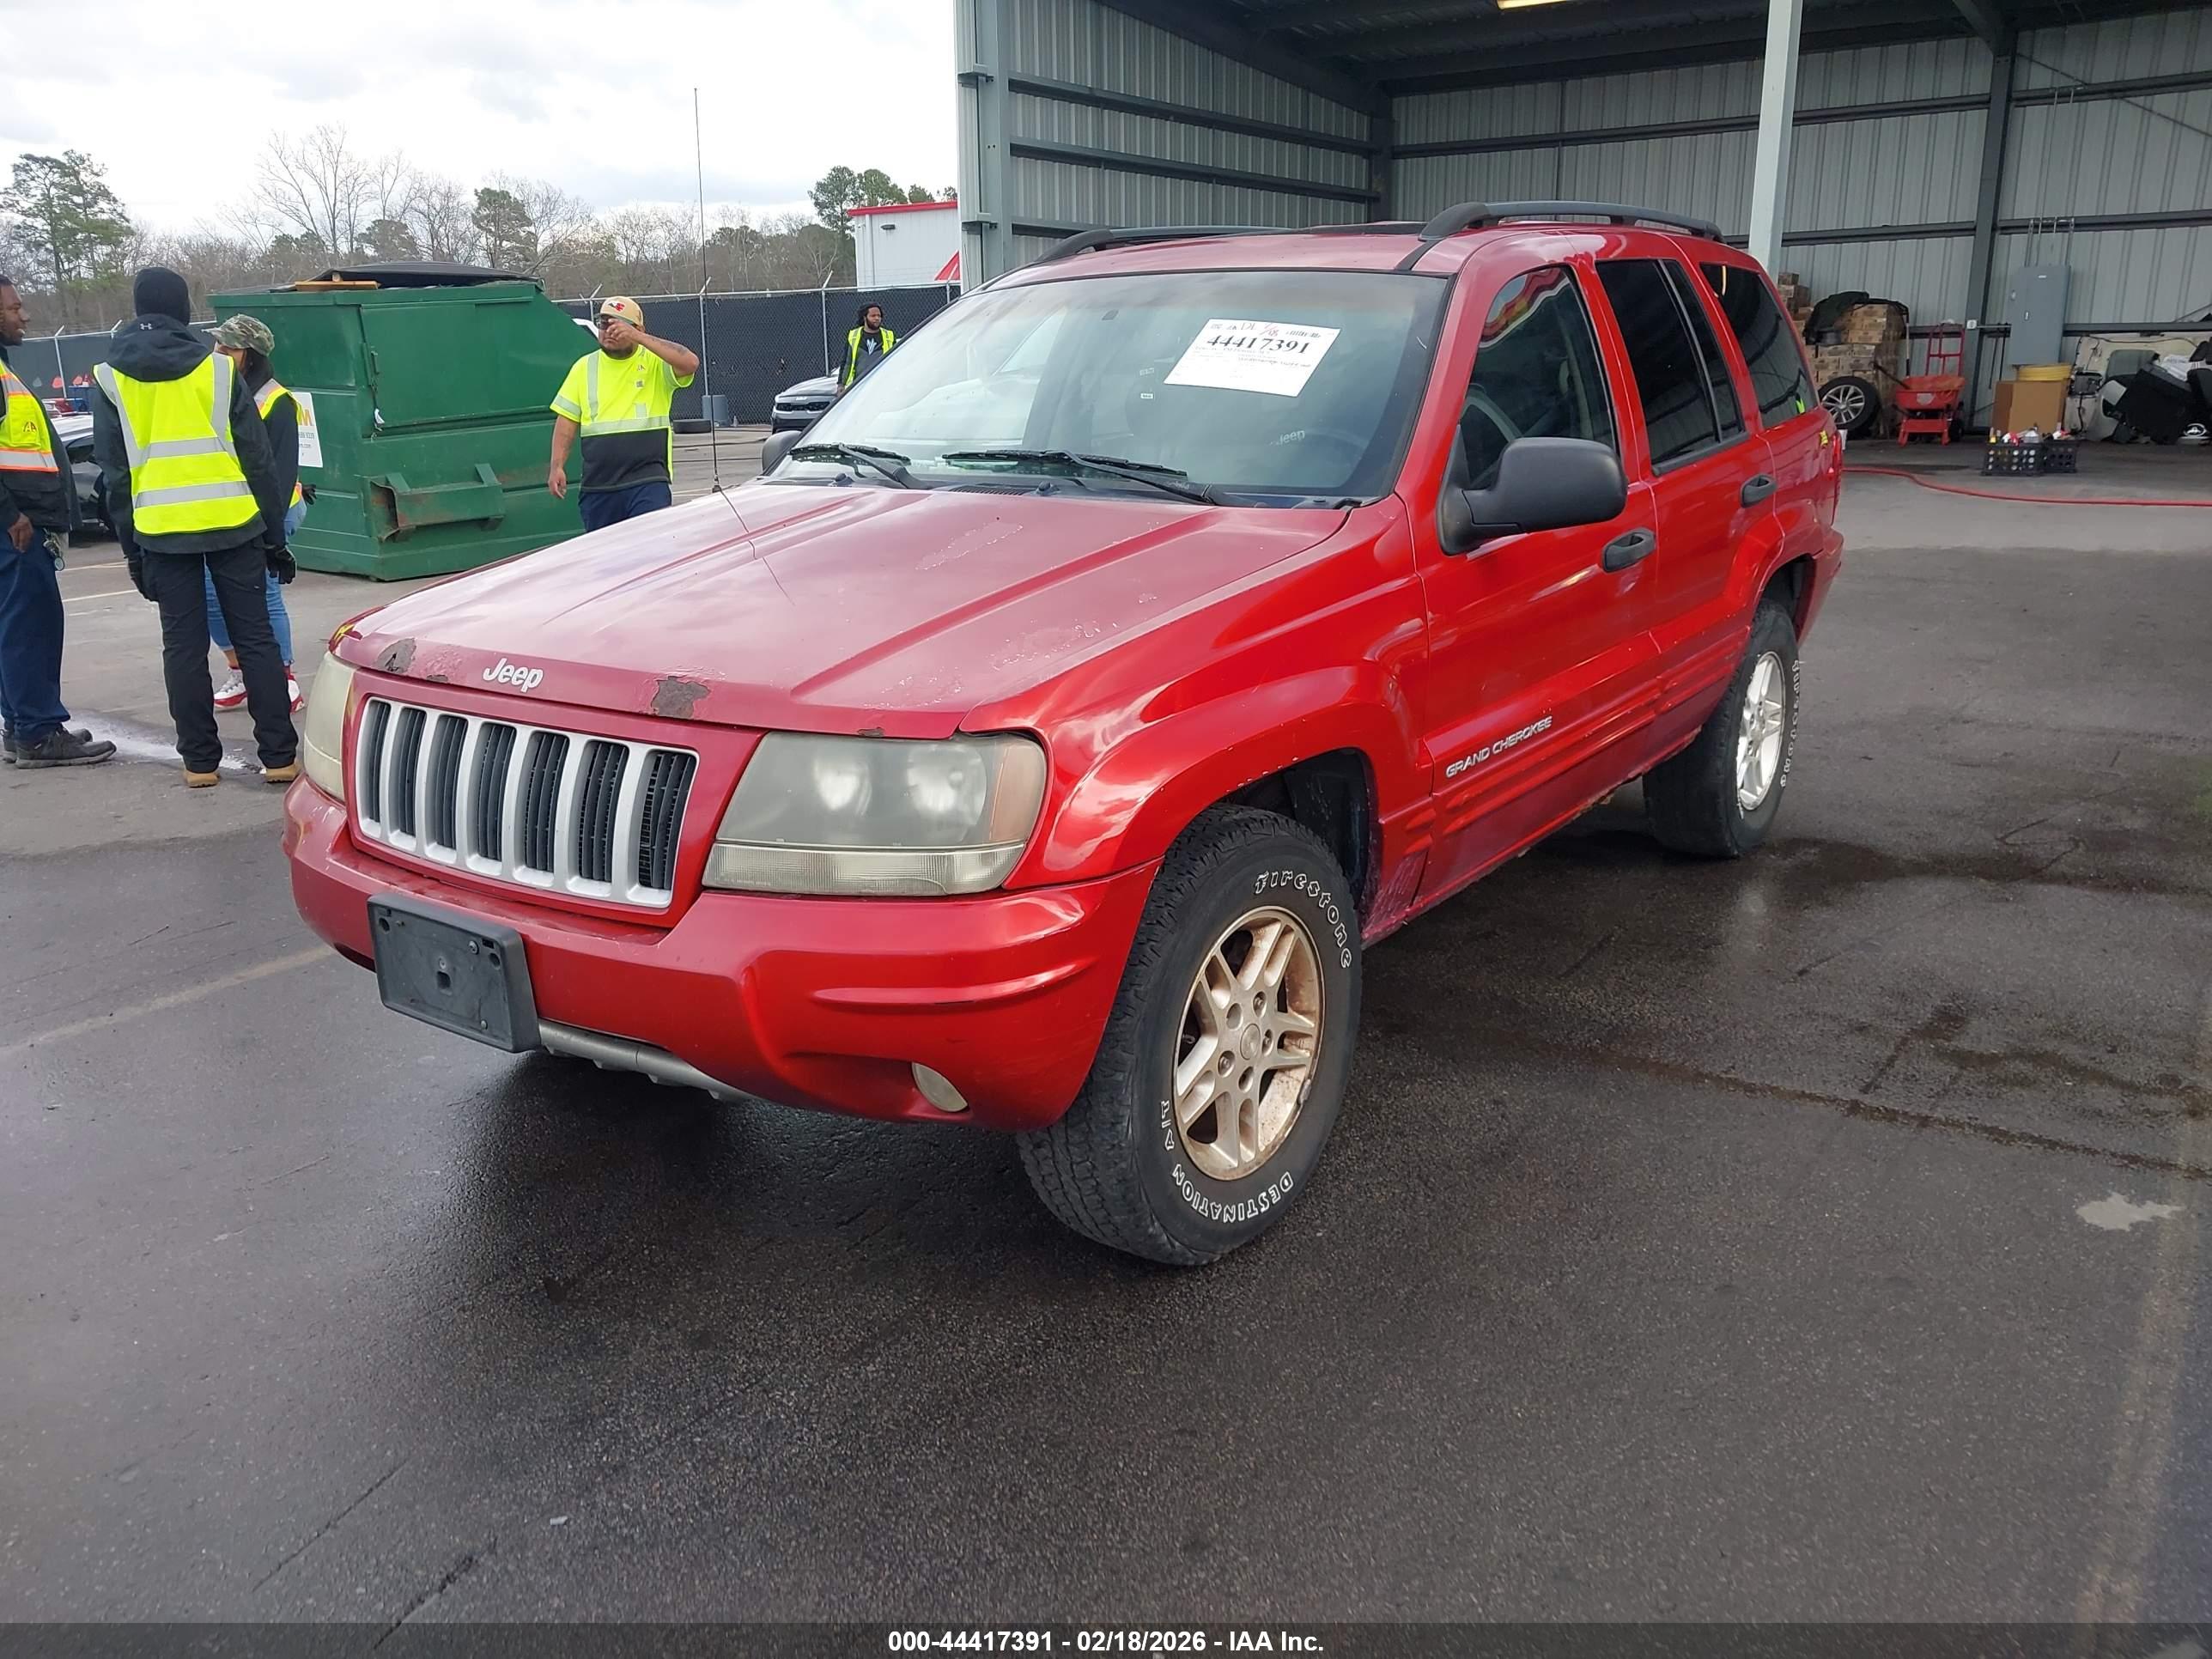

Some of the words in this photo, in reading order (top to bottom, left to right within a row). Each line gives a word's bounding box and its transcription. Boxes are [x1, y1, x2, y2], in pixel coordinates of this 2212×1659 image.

[1207, 335, 1310, 354] 44417391
[483, 657, 544, 693] Jeep
[1446, 747, 1490, 778] GRAND
[1492, 715, 1553, 754] CHEROKEE
[1255, 870, 1352, 969] Firestone
[1171, 1164, 1294, 1223] DESTINATION
